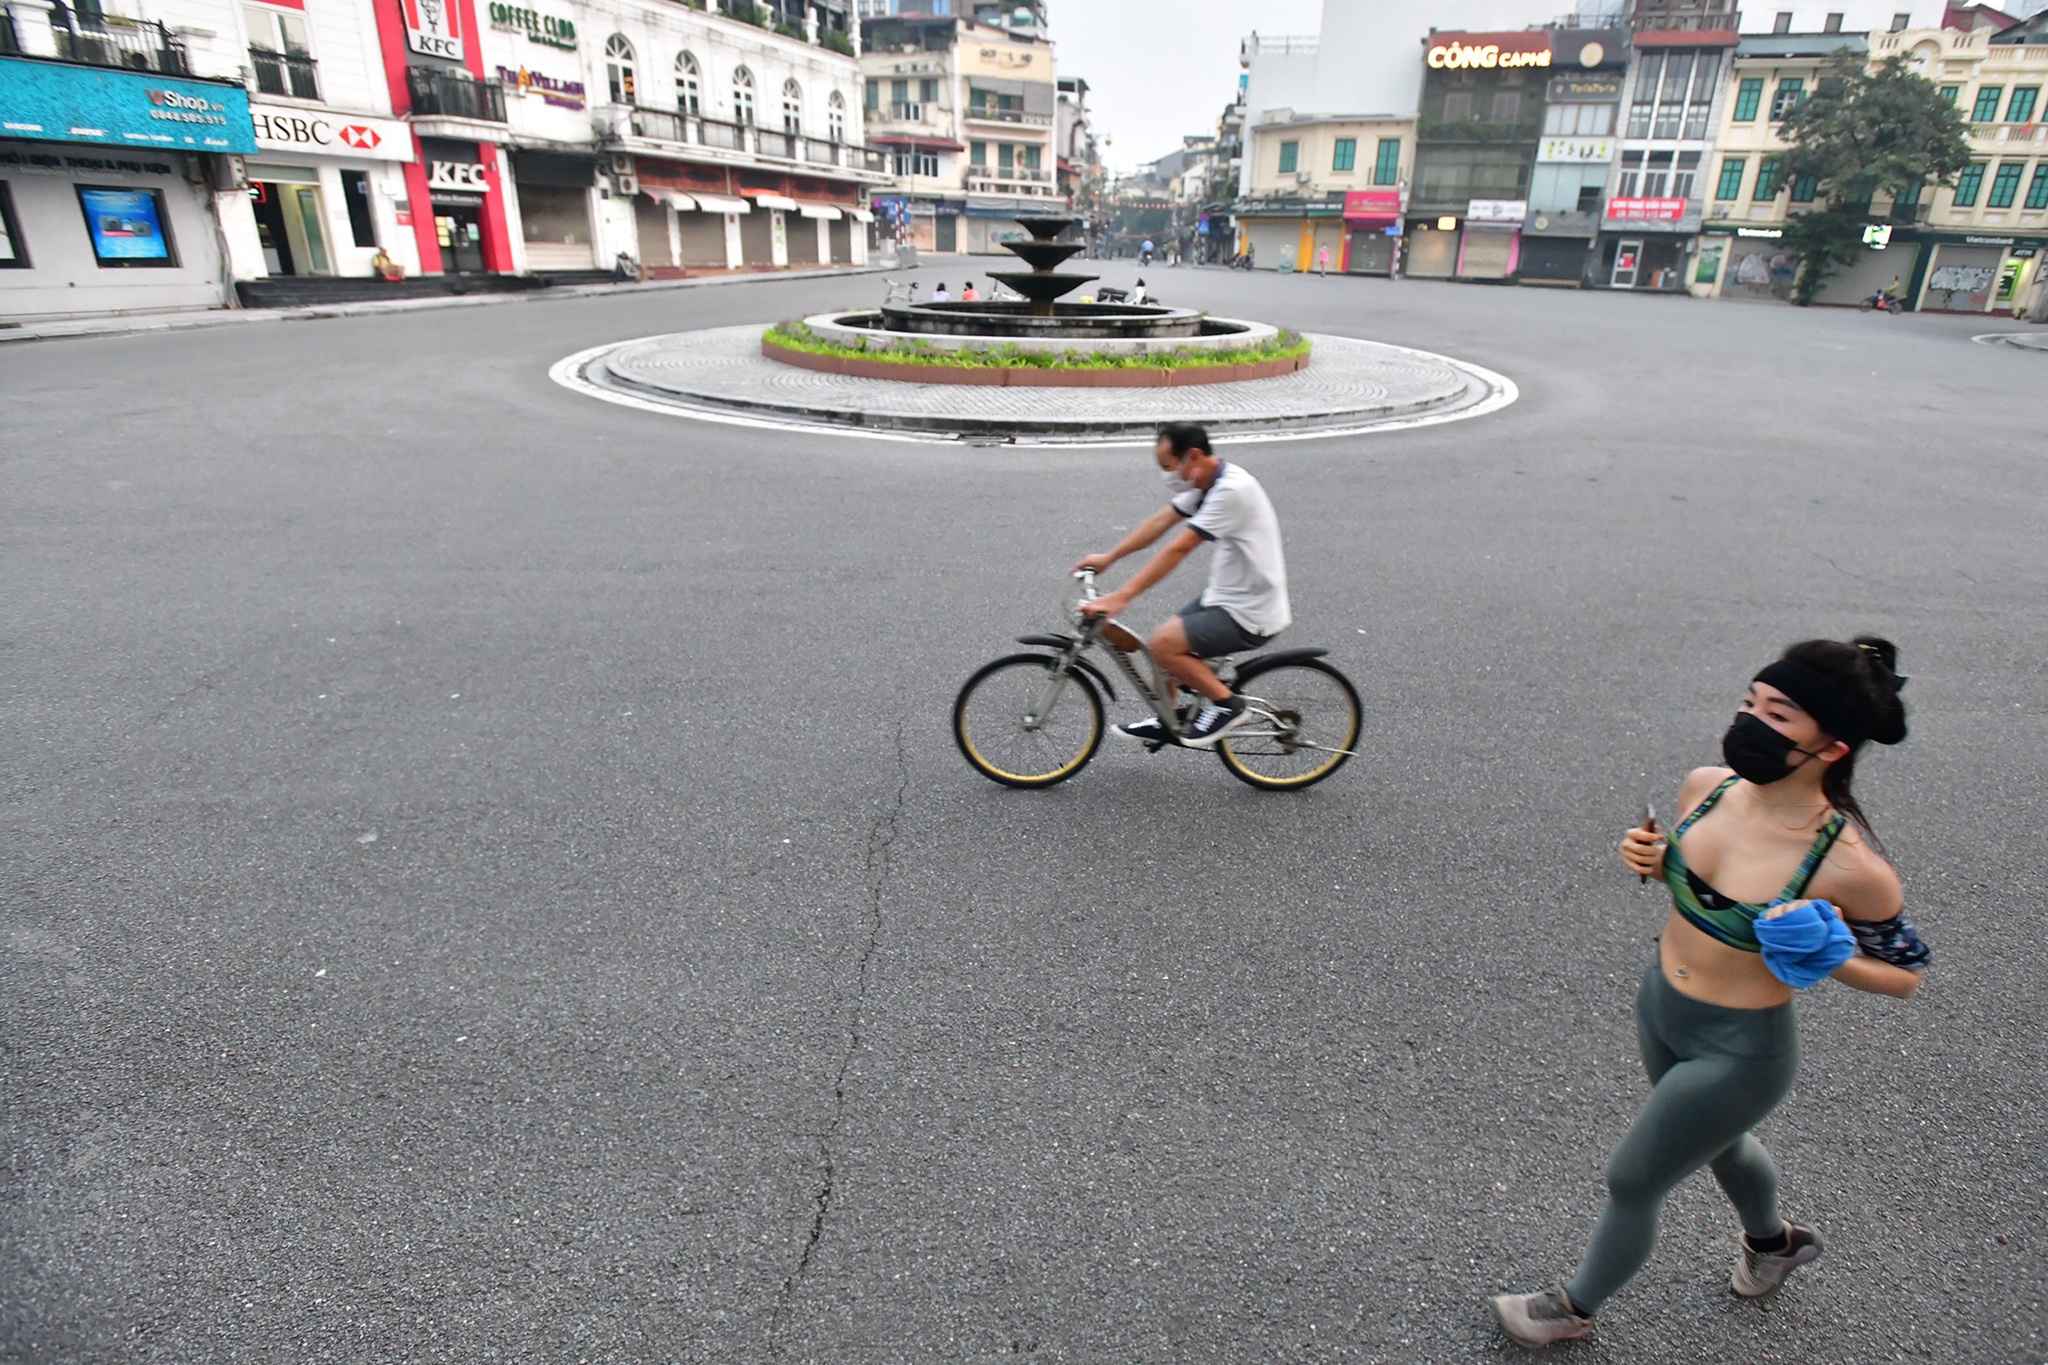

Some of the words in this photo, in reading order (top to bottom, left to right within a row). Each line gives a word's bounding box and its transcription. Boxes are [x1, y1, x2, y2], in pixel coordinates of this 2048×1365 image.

[489, 1, 540, 33] COFFEE
[419, 35, 456, 56] KFC
[251, 113, 331, 146] HSBC
[431, 160, 488, 186] KFC
[1966, 235, 2015, 245] Vietcombank
